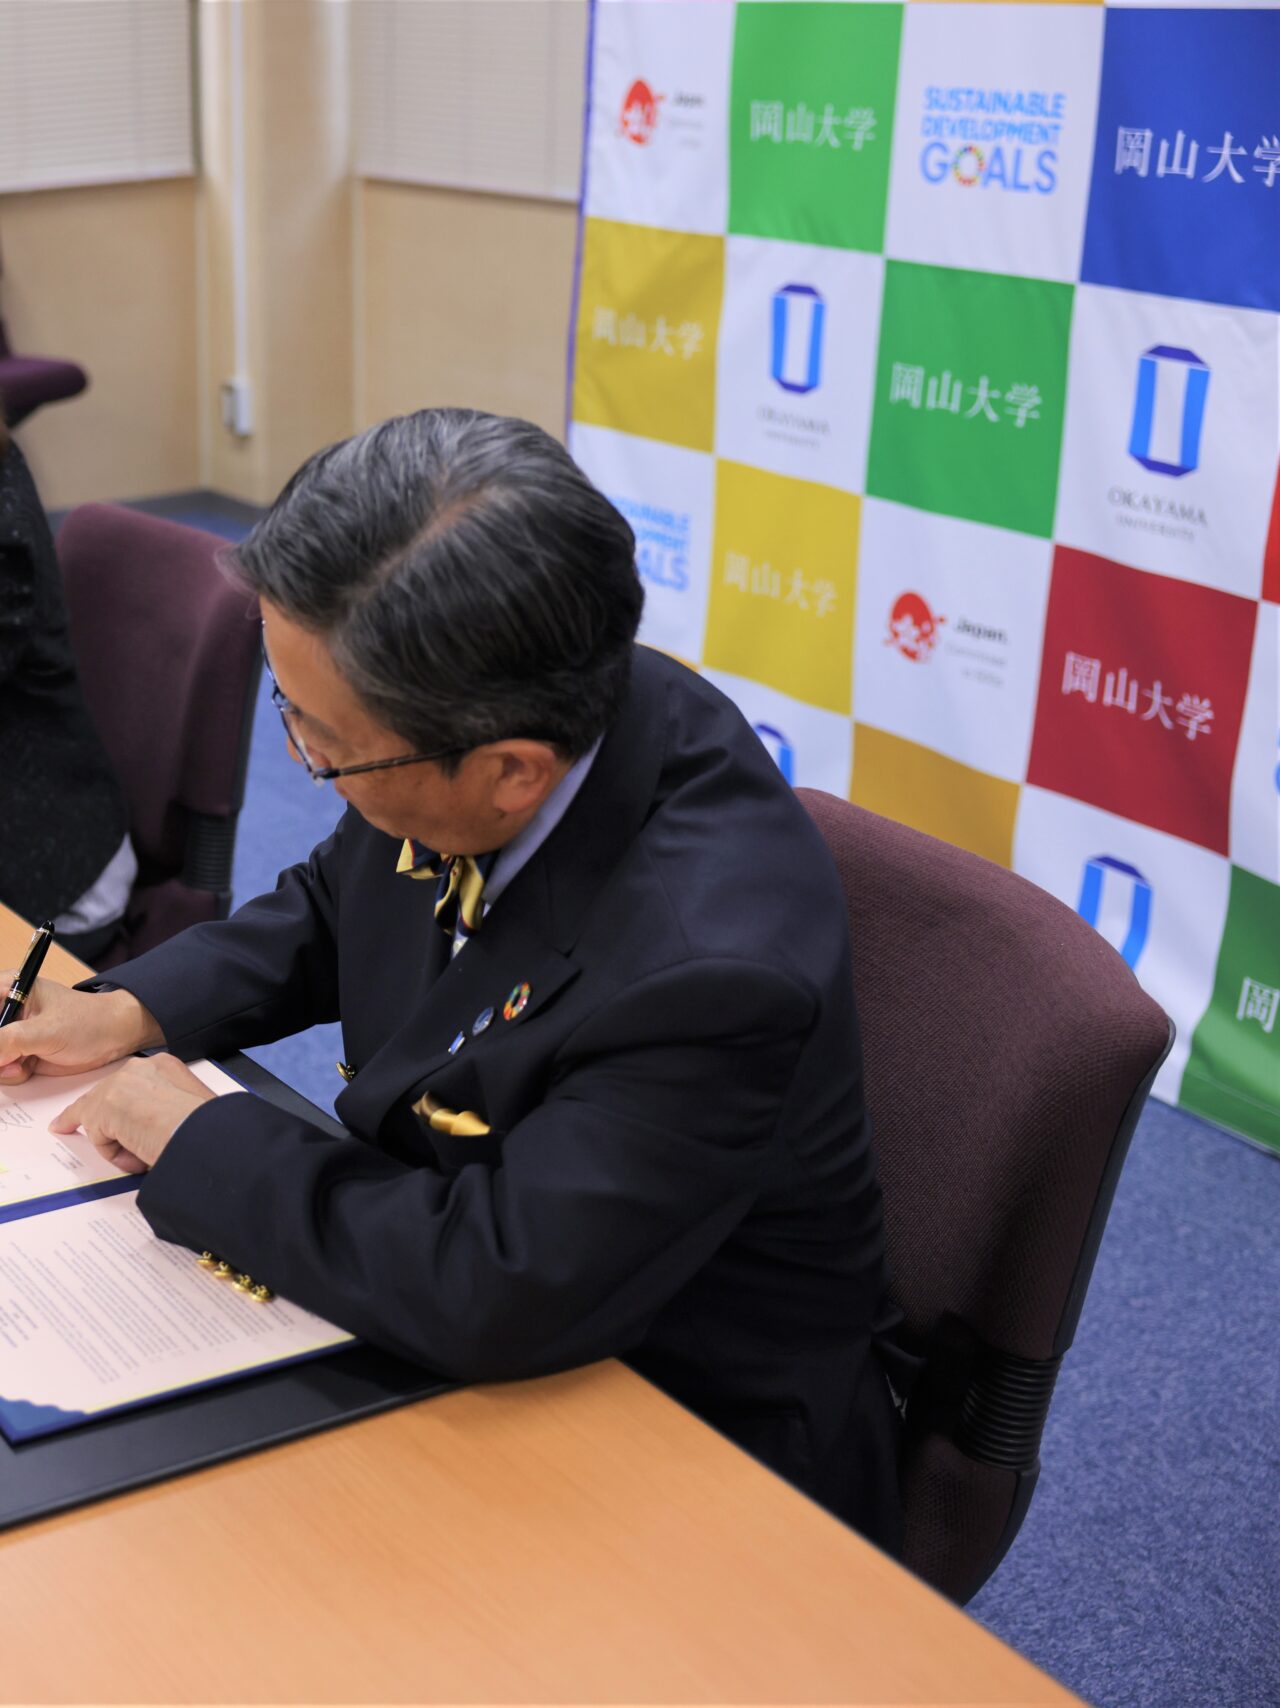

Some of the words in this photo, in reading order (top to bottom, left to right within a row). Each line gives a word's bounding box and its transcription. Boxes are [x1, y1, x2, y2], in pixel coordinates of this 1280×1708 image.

[750, 99, 877, 150] 岡山大学
[926, 86, 1066, 119] SUSTAINABLE
[922, 115, 1061, 145] DEVELOPMENT
[920, 142, 1057, 194] GOALS
[890, 362, 1042, 428] 岡山大学
[1108, 486, 1208, 528] OKAYAMA
[724, 550, 838, 617] 岡山大学
[1061, 651, 1214, 740] 岡山大学
